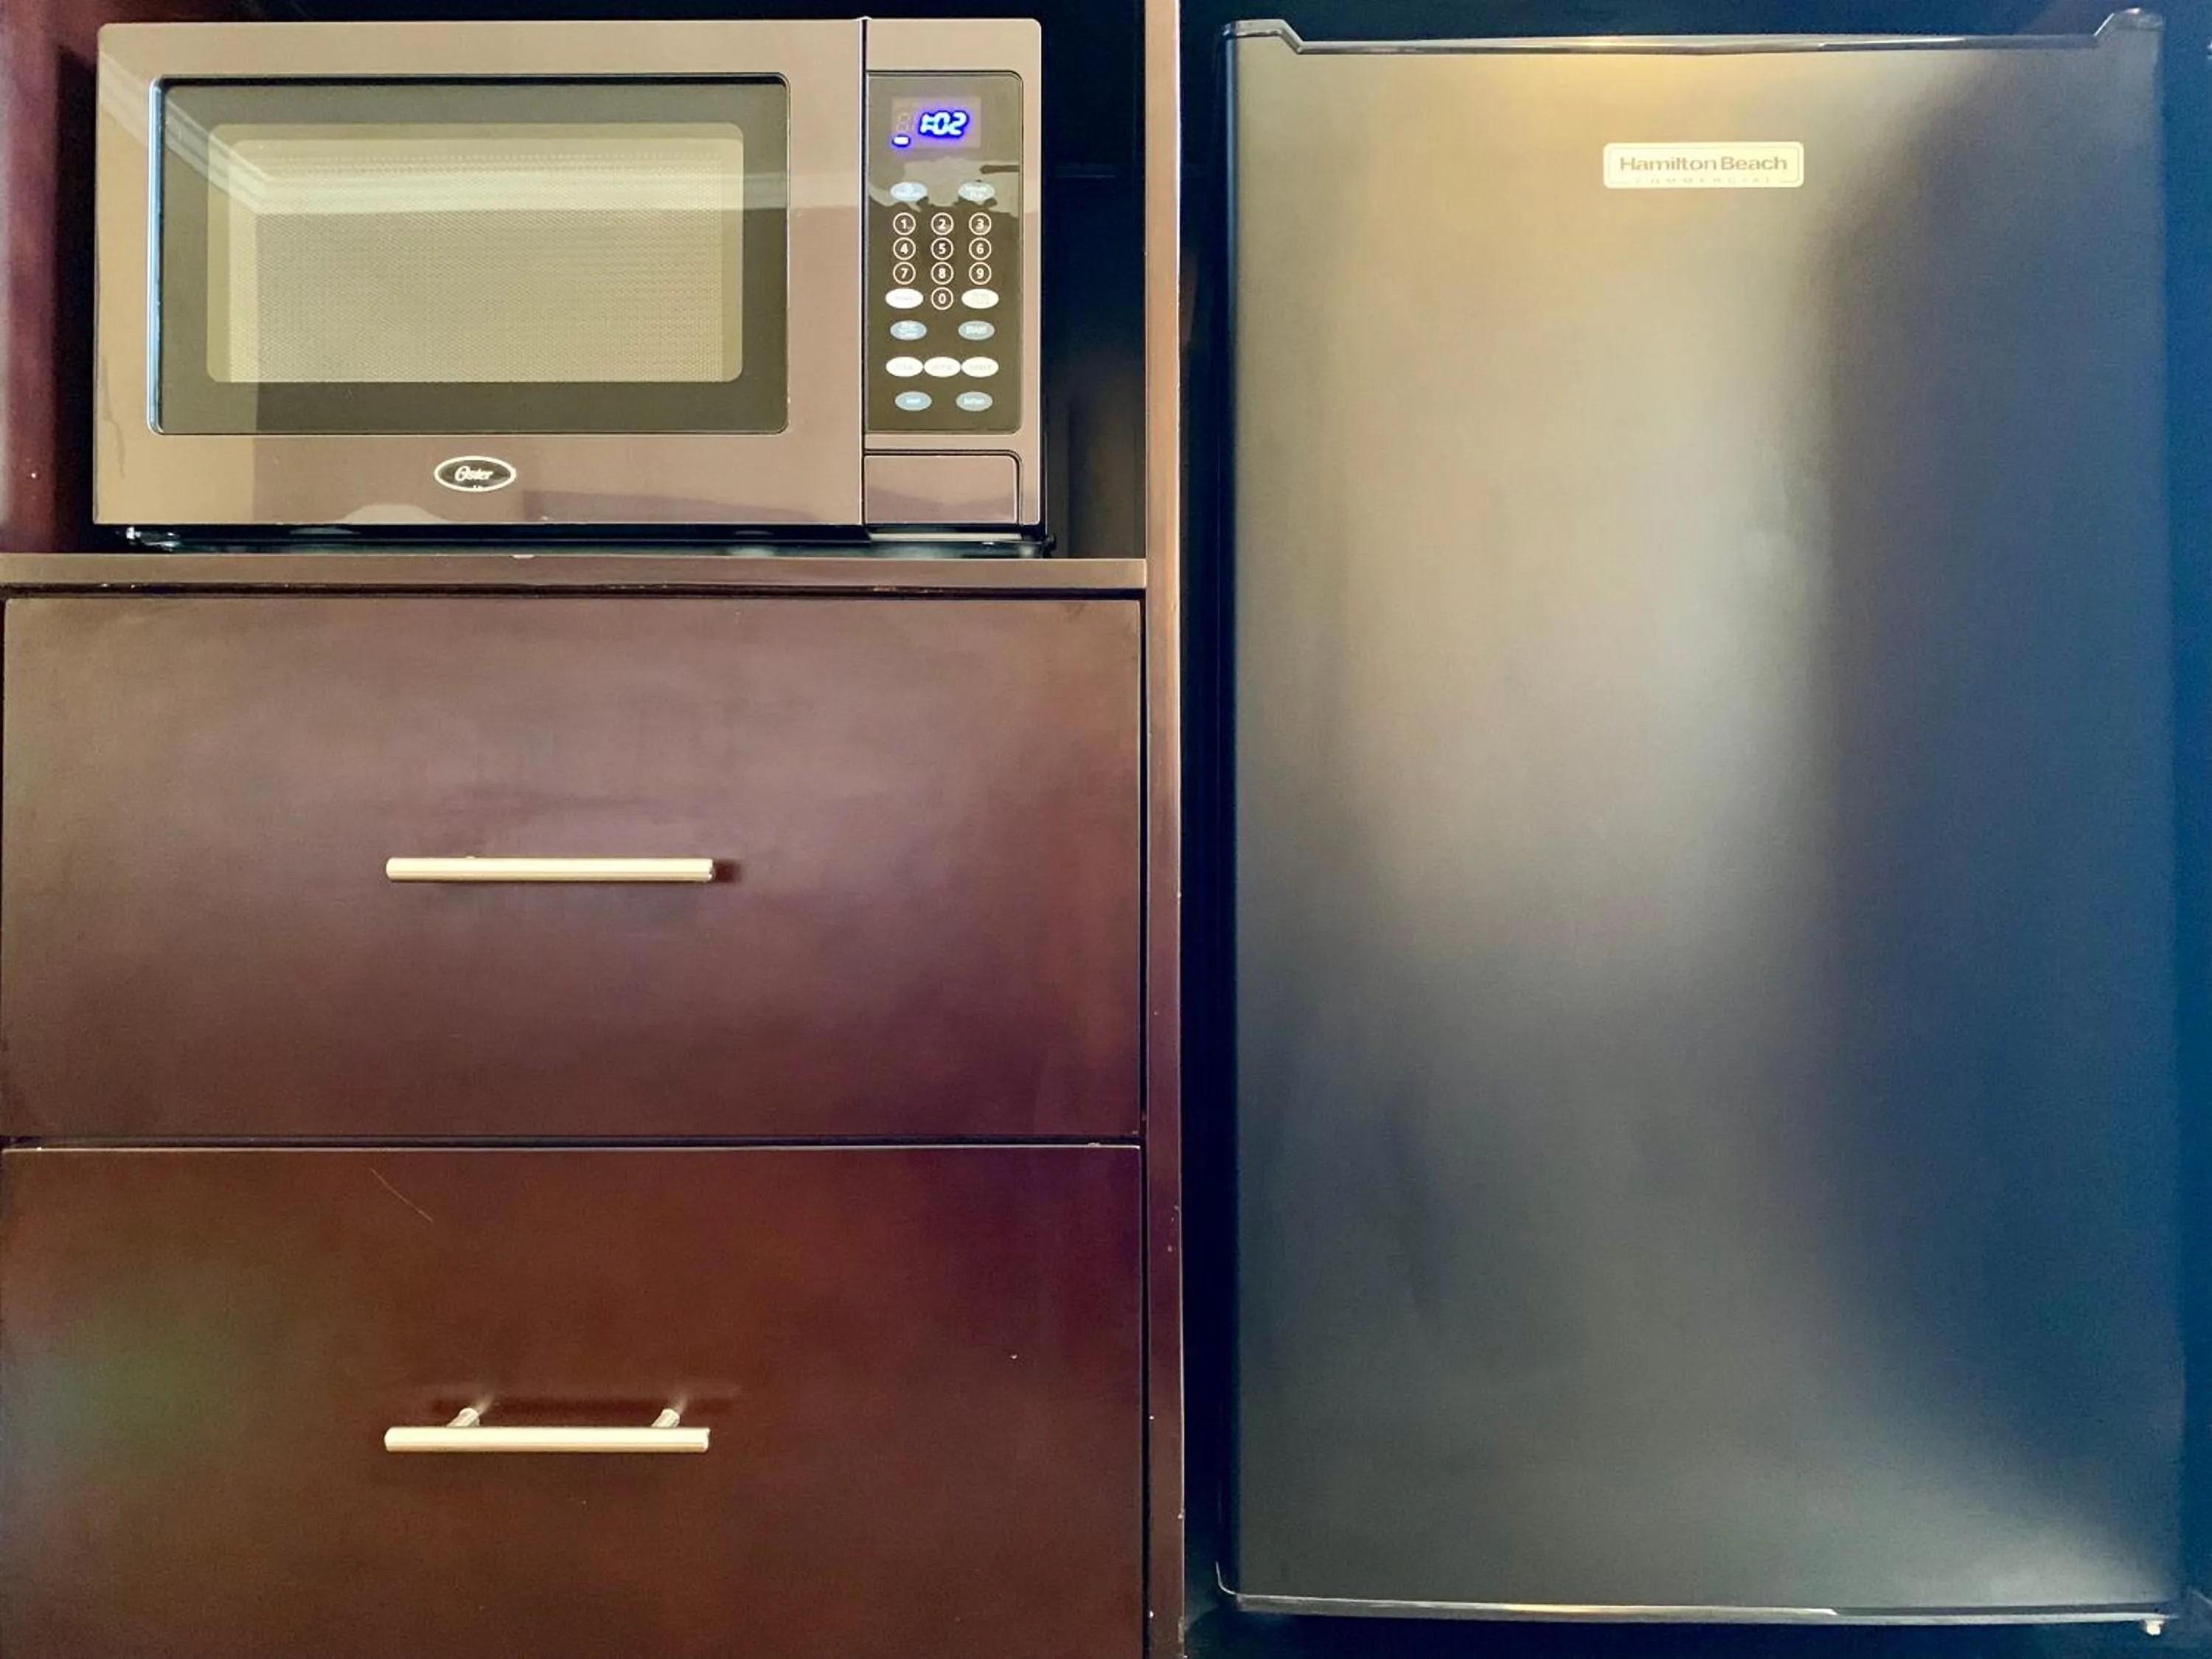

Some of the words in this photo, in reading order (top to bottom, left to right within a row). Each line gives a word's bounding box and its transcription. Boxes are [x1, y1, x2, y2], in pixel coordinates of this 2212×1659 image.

[1620, 156, 1717, 171] Hamilton
[1720, 156, 1788, 170] Beach
[900, 218, 908, 229] 1
[938, 218, 947, 229] 2
[975, 218, 984, 229] 3
[900, 243, 909, 254] 4
[938, 243, 947, 254] 5
[975, 243, 984, 254] 6
[900, 267, 909, 279] 7
[938, 268, 947, 279] 8
[975, 268, 984, 279] 9
[938, 293, 947, 305] 0
